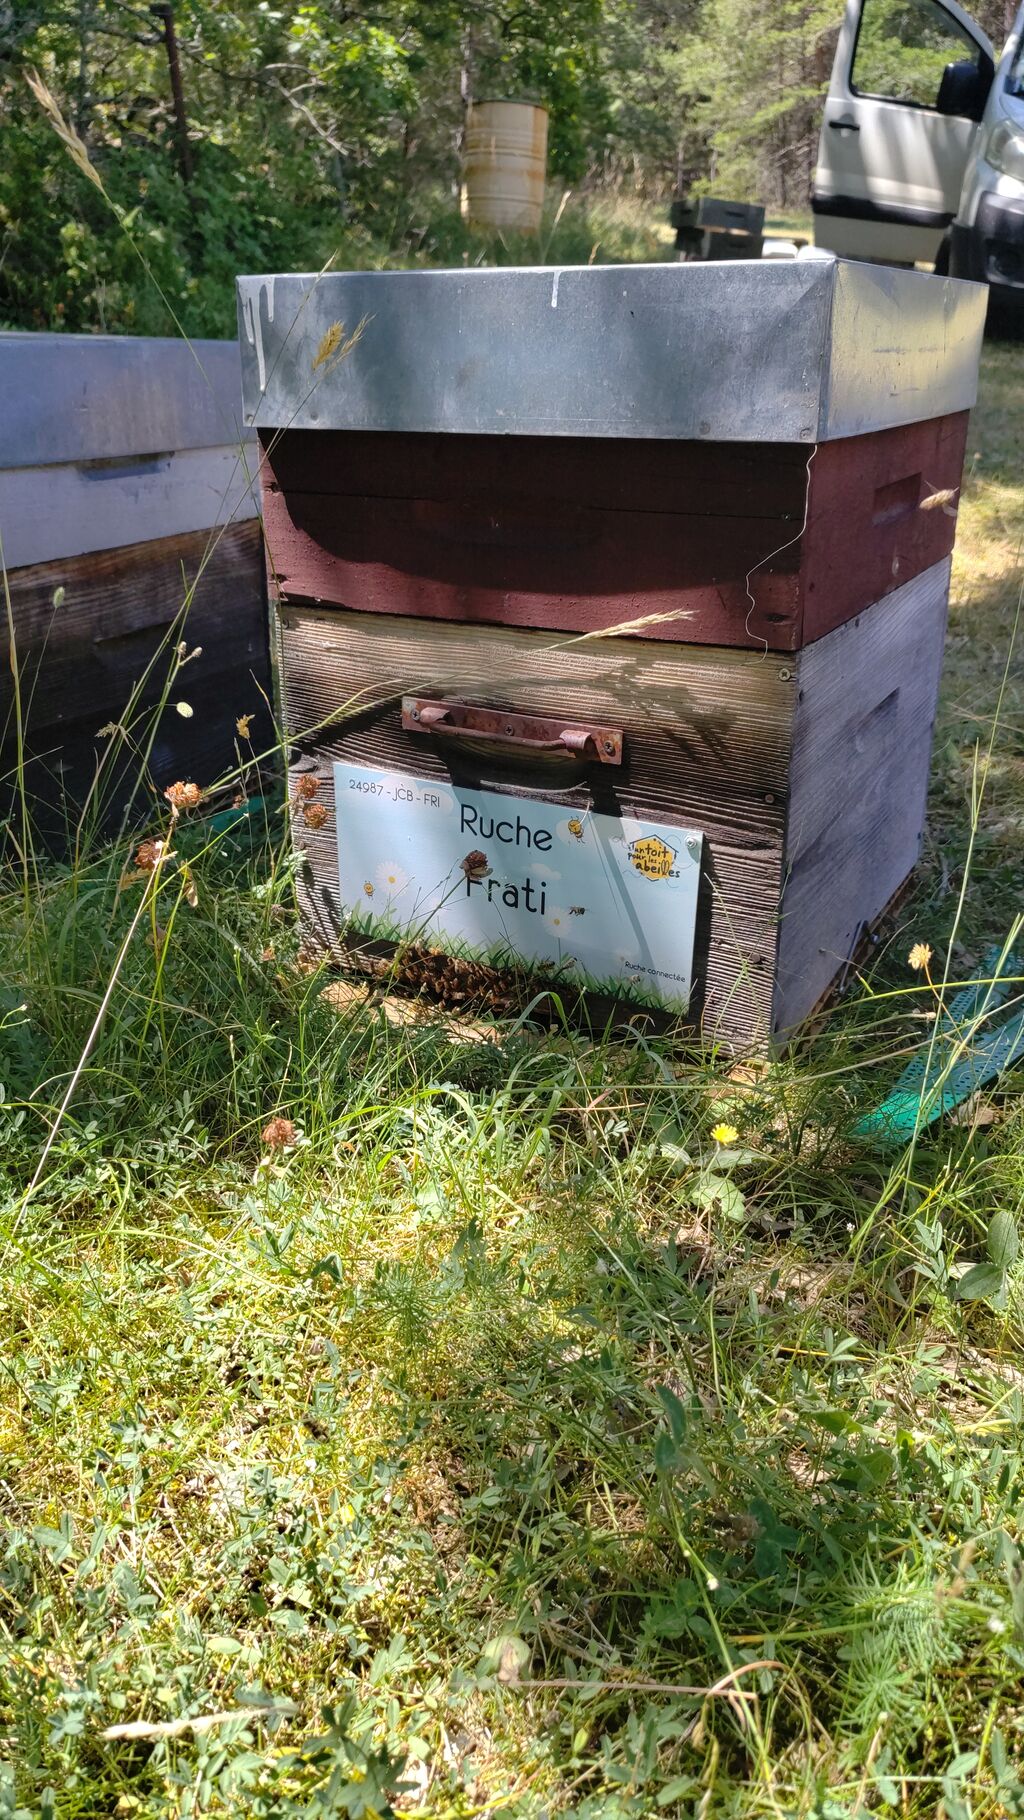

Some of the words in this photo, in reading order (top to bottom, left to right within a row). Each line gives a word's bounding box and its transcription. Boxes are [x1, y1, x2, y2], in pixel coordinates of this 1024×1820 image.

[348, 779, 384, 796] 24987
[423, 793, 440, 808] FRI
[461, 803, 553, 851] Ruche
[627, 852, 647, 861] pour
[635, 859, 681, 878] abeilles
[466, 875, 547, 915] Frati
[625, 960, 646, 973] Ruche
[647, 968, 686, 983] connectée
